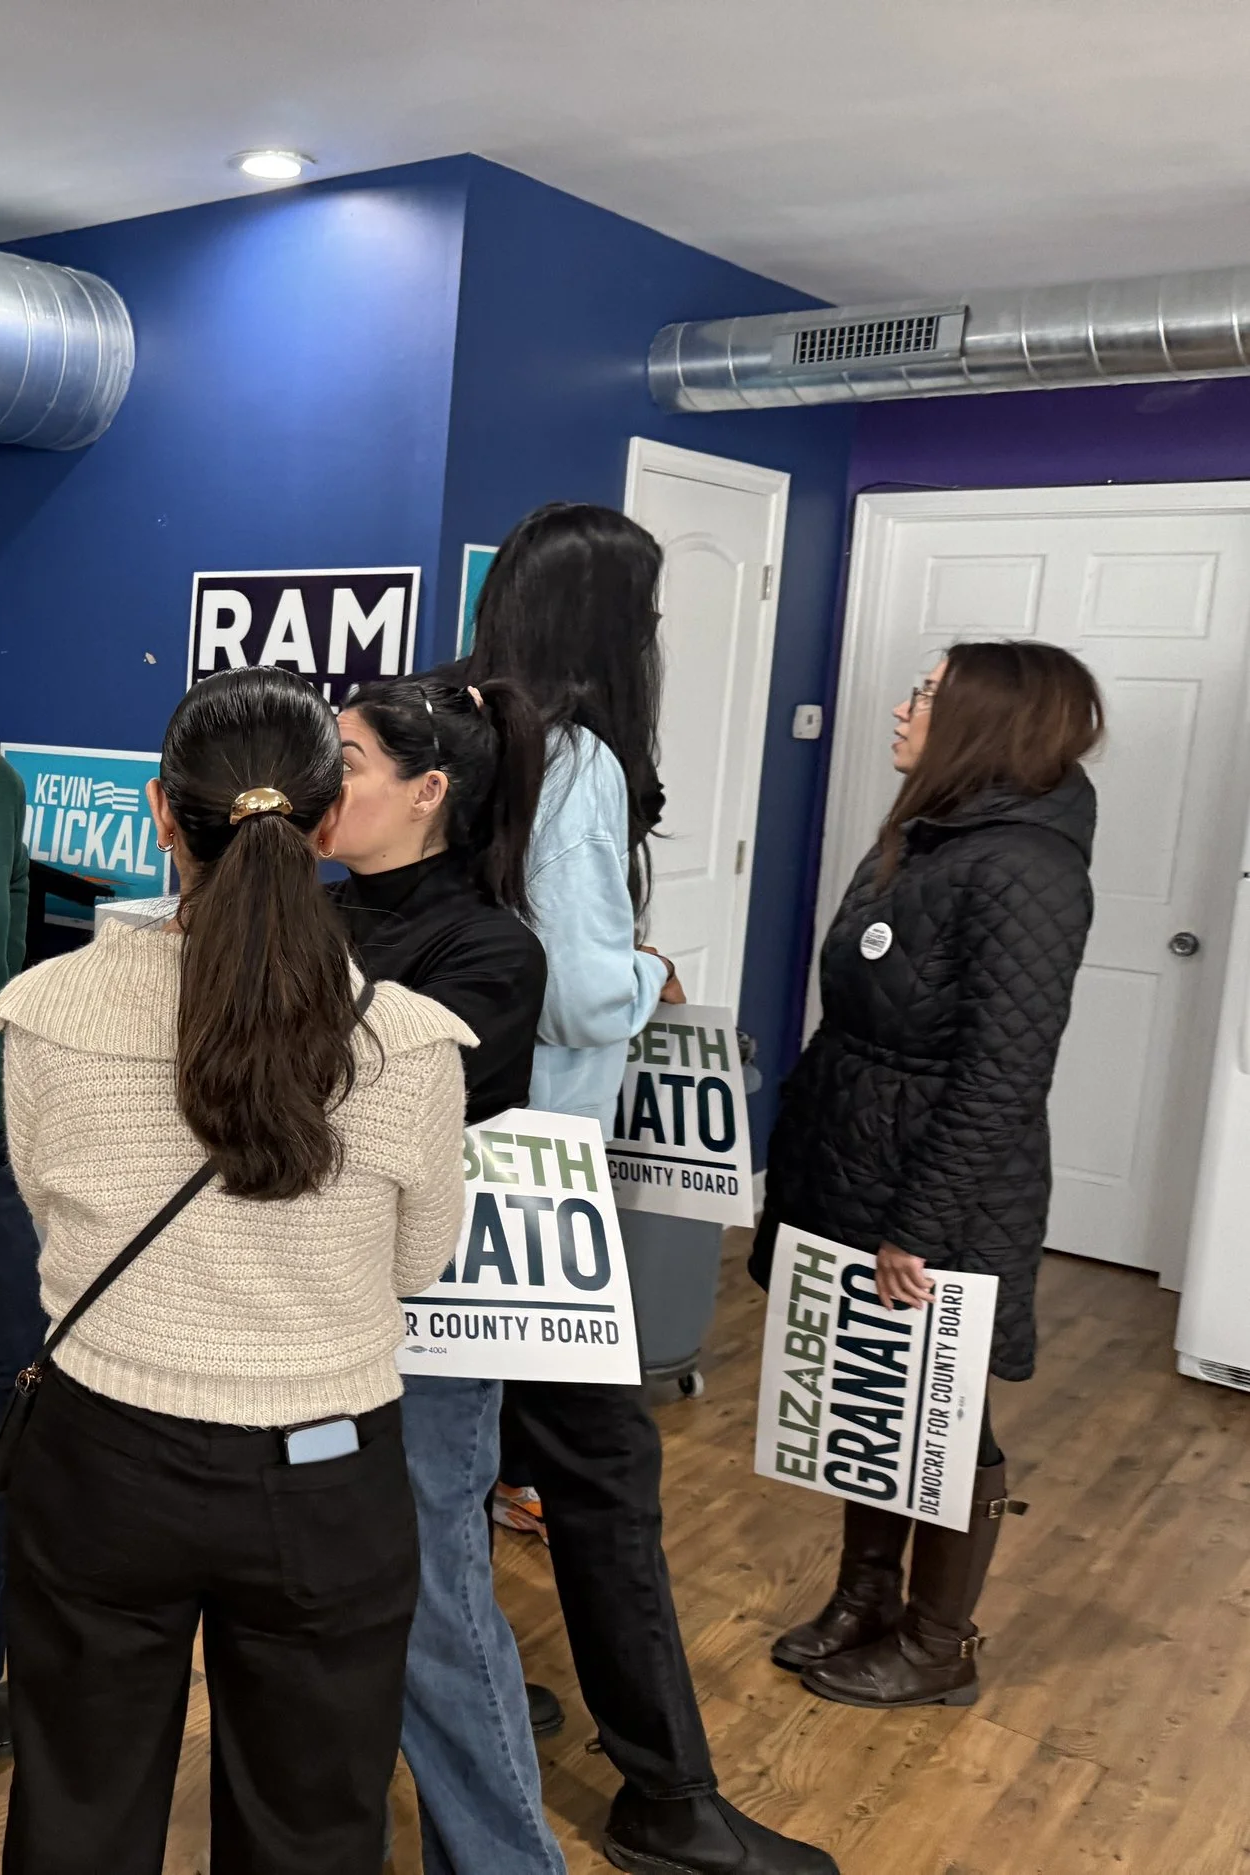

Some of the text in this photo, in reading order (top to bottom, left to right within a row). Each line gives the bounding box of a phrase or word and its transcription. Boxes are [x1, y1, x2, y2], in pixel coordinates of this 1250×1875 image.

[198, 587, 406, 676] RAM
[34, 773, 93, 809] KEVIN
[610, 1161, 739, 1196] COUNTY BOARD
[439, 1192, 611, 1291] ATO
[430, 1313, 529, 1341] COUNTY
[541, 1318, 619, 1345] BOARD
[775, 1243, 837, 1482] ELIZABETH
[919, 1283, 964, 1516] DEMOCRAT FOR COUNTY BOARD
